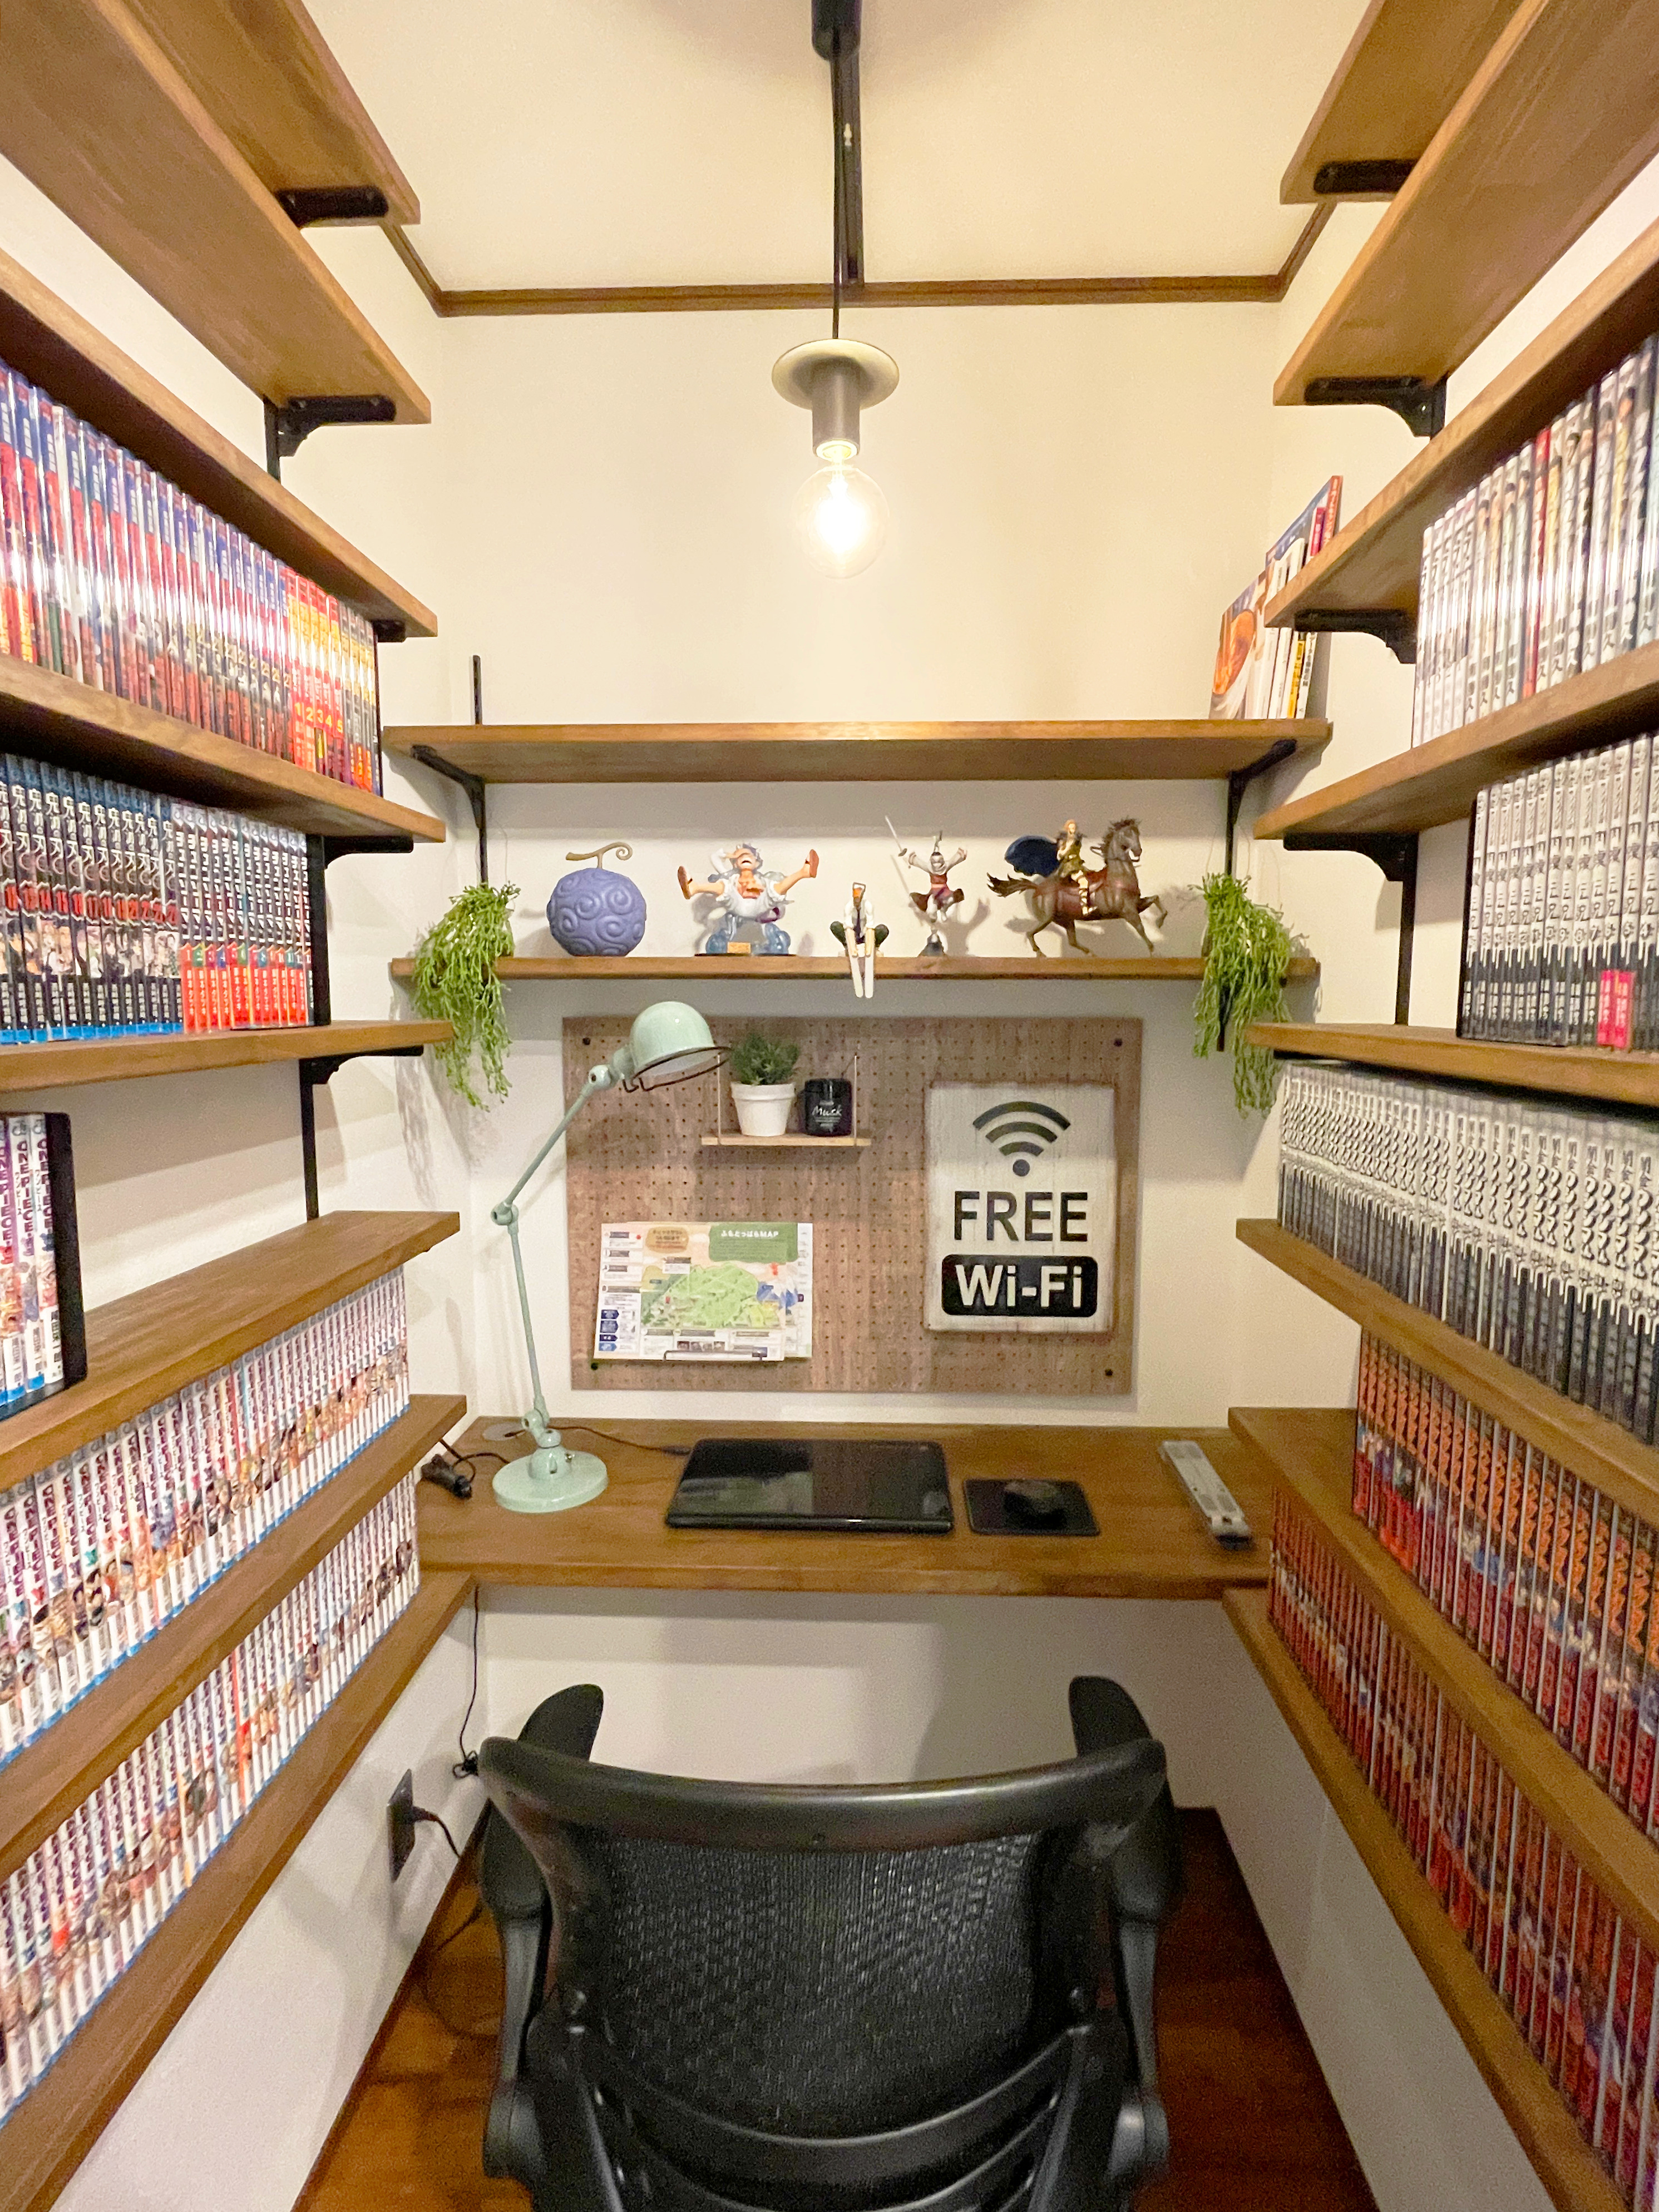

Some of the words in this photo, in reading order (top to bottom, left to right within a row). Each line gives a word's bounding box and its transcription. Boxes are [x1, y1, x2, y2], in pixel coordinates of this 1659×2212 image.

[295, 702, 300, 716] 1
[306, 707, 313, 722] 2
[317, 709, 323, 723] 3
[325, 715, 332, 728] 4
[337, 720, 343, 733] 5
[17, 1141, 29, 1174] ONE
[21, 1176, 33, 1232] PIECE
[954, 1191, 1088, 1241] FREE
[955, 1264, 1083, 1308] Wi-Fi
[80, 1463, 92, 1495] ONE
[23, 1495, 37, 1530] ONE
[43, 1484, 56, 1517] ONE
[4, 1507, 18, 1541] ONE
[84, 1494, 97, 1546] PIECE
[29, 1529, 43, 1583] PIECE
[48, 1517, 63, 1570] PIECE
[10, 1542, 23, 1597] PIECE
